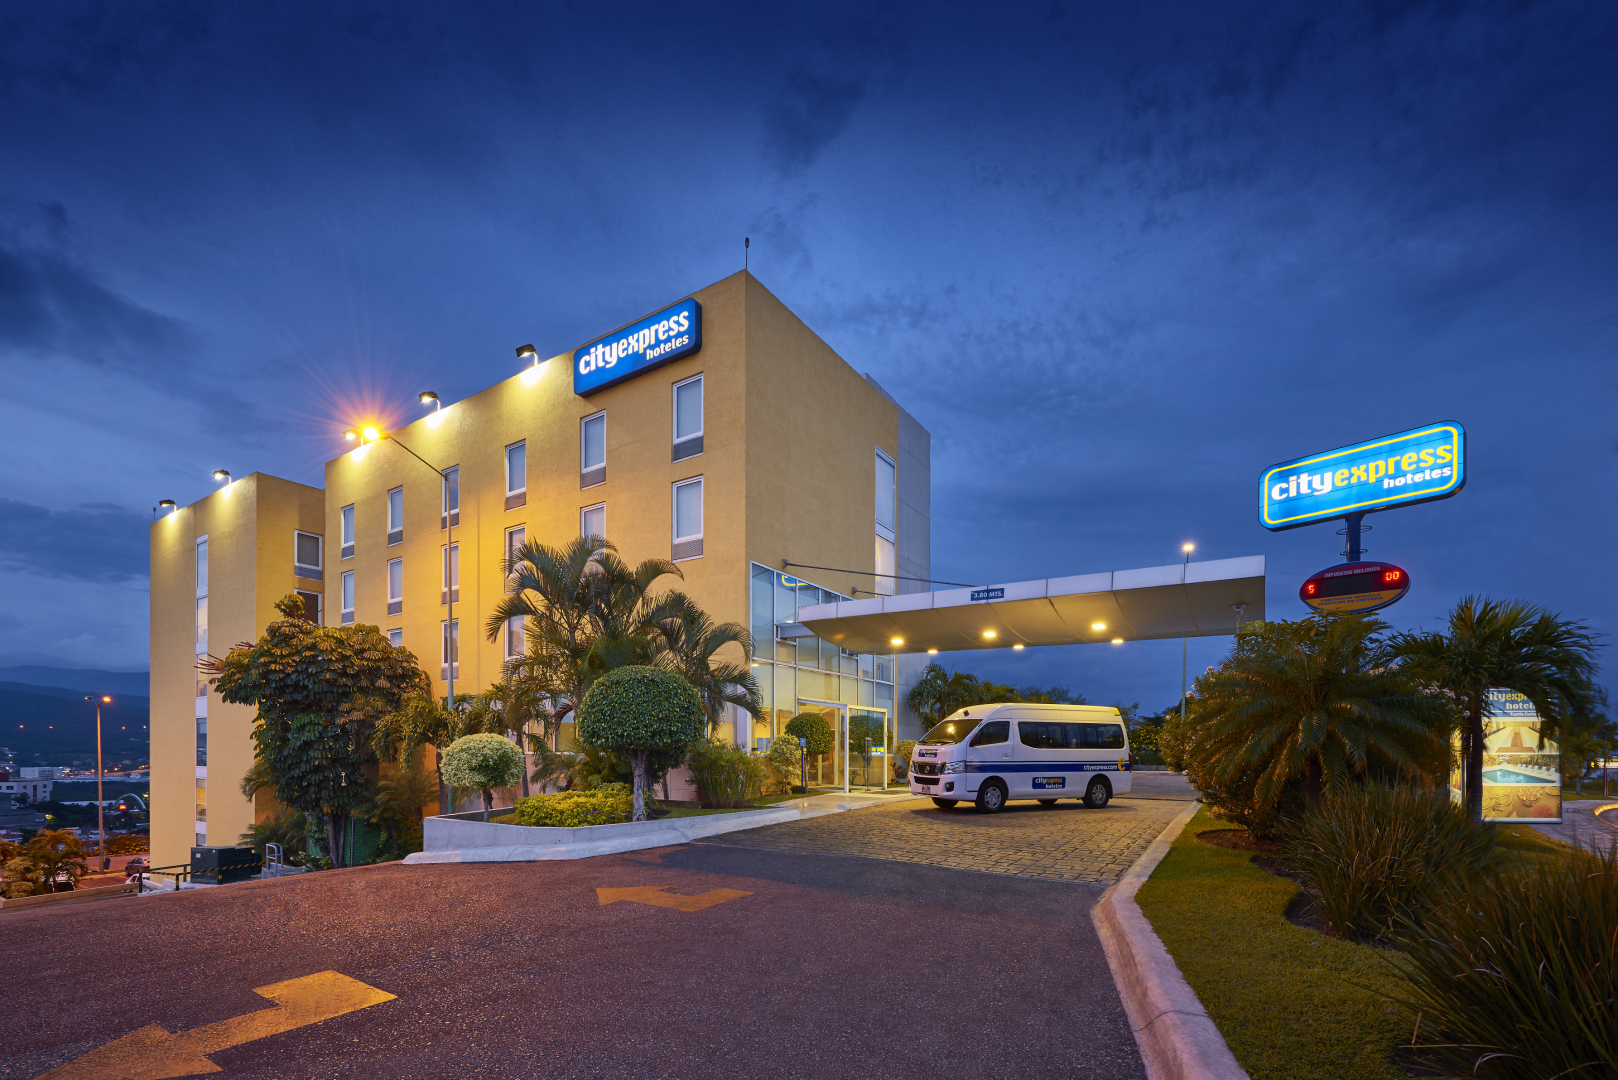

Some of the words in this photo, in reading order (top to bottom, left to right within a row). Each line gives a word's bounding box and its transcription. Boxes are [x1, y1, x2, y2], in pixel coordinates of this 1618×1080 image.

[579, 311, 689, 375] cityexpress
[646, 335, 689, 361] hoteles
[1271, 445, 1453, 500] cityexpress
[1383, 467, 1452, 489] hoteles
[1035, 777, 1063, 785] cityexpress
